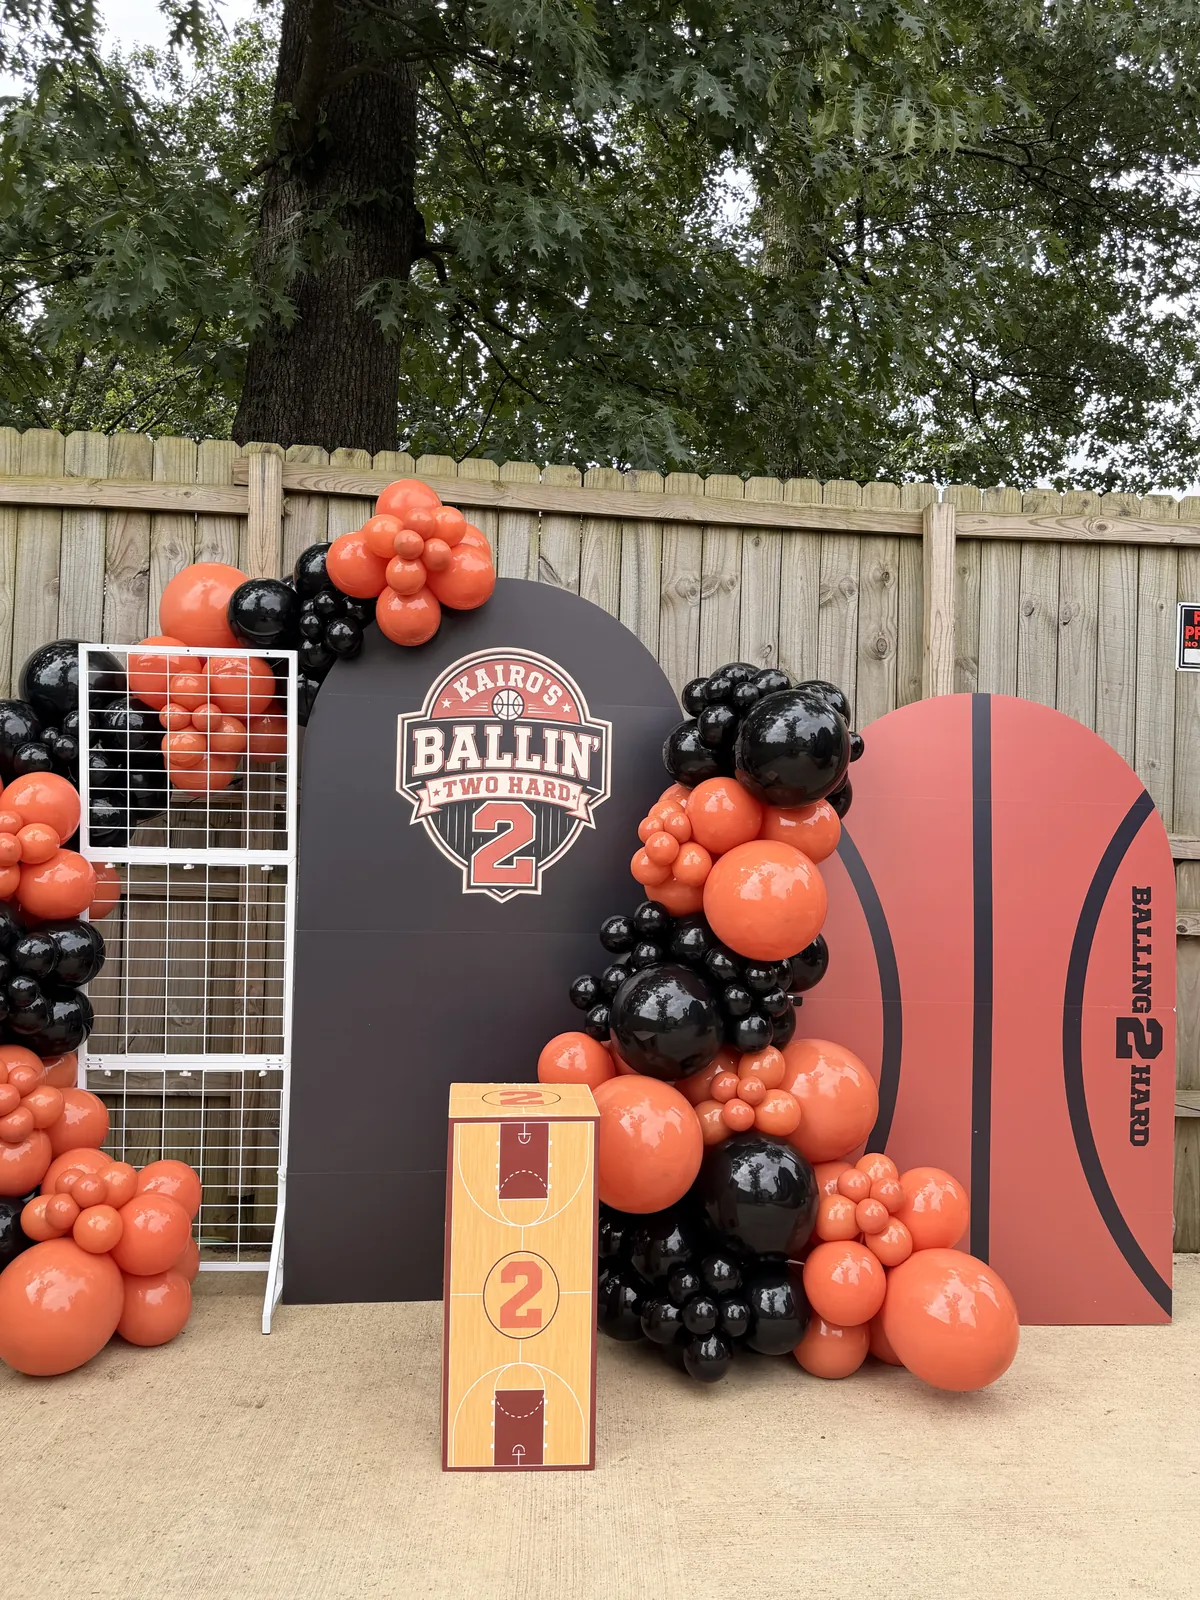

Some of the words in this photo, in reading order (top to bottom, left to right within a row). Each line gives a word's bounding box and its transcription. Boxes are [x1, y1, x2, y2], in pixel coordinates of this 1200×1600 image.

[454, 665, 562, 706] KAIRO'S
[412, 725, 600, 780] BALLIN'
[442, 776, 499, 798] TWO
[508, 776, 571, 802] HARD
[471, 801, 536, 886] 2
[1132, 886, 1151, 1013] BALLING
[1116, 1017, 1163, 1059] 2
[499, 1090, 545, 1105] 2
[1129, 1064, 1151, 1147] HARD
[500, 1261, 542, 1328] 2
